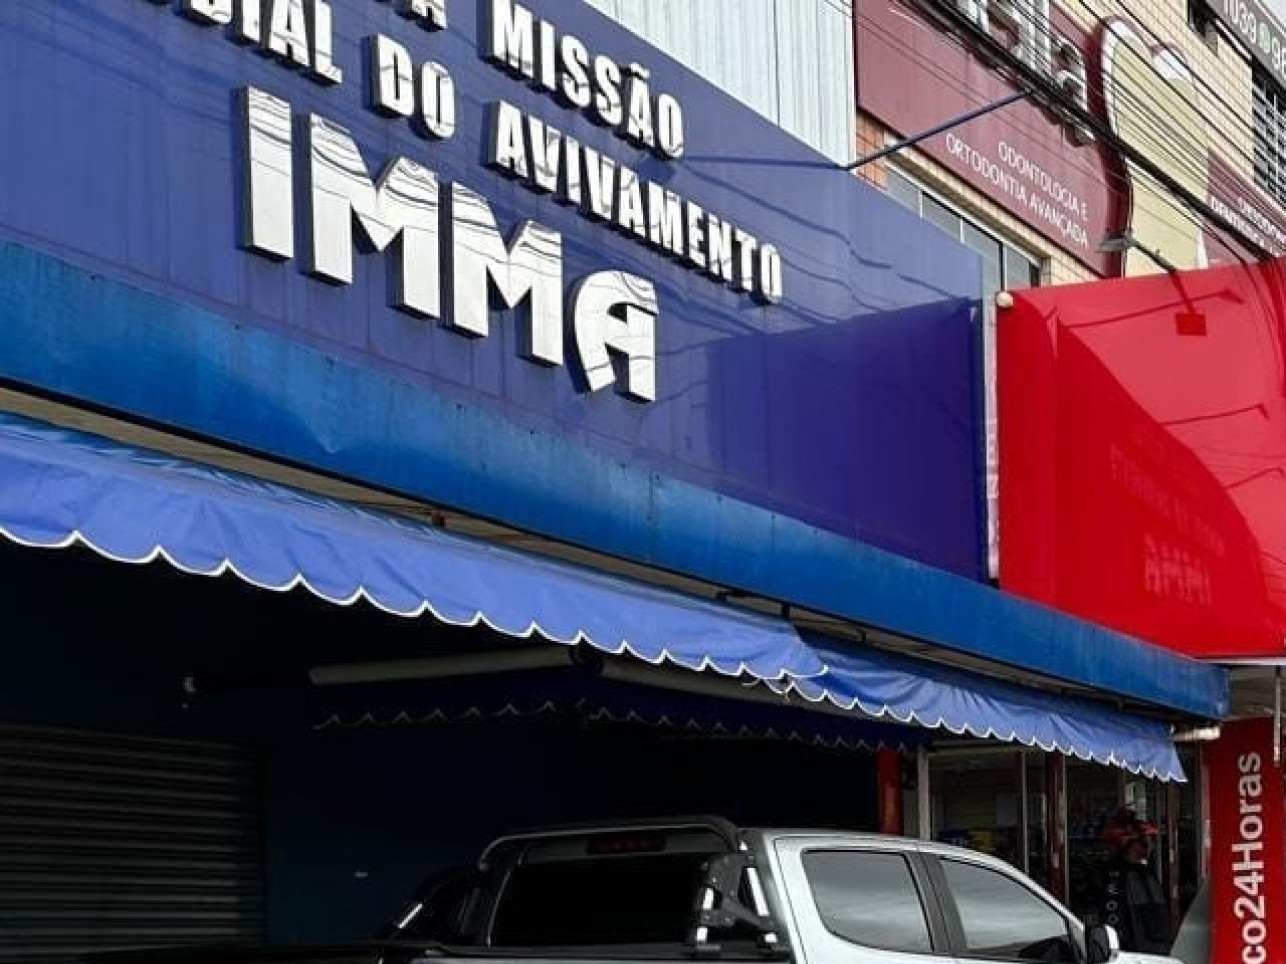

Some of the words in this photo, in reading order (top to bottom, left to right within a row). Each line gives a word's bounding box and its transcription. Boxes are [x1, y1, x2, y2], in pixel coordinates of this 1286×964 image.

[374, 33, 455, 138] DO
[491, 0, 684, 159] MISSÃO
[246, 86, 659, 402] IMMA
[495, 100, 783, 303] AVIVAMENTO
[945, 133, 1028, 206] ORTODONTIA
[1030, 193, 1088, 248] AVANÇADA
[998, 141, 1080, 215] ODONTOLOGIA
[1081, 202, 1088, 222] E
